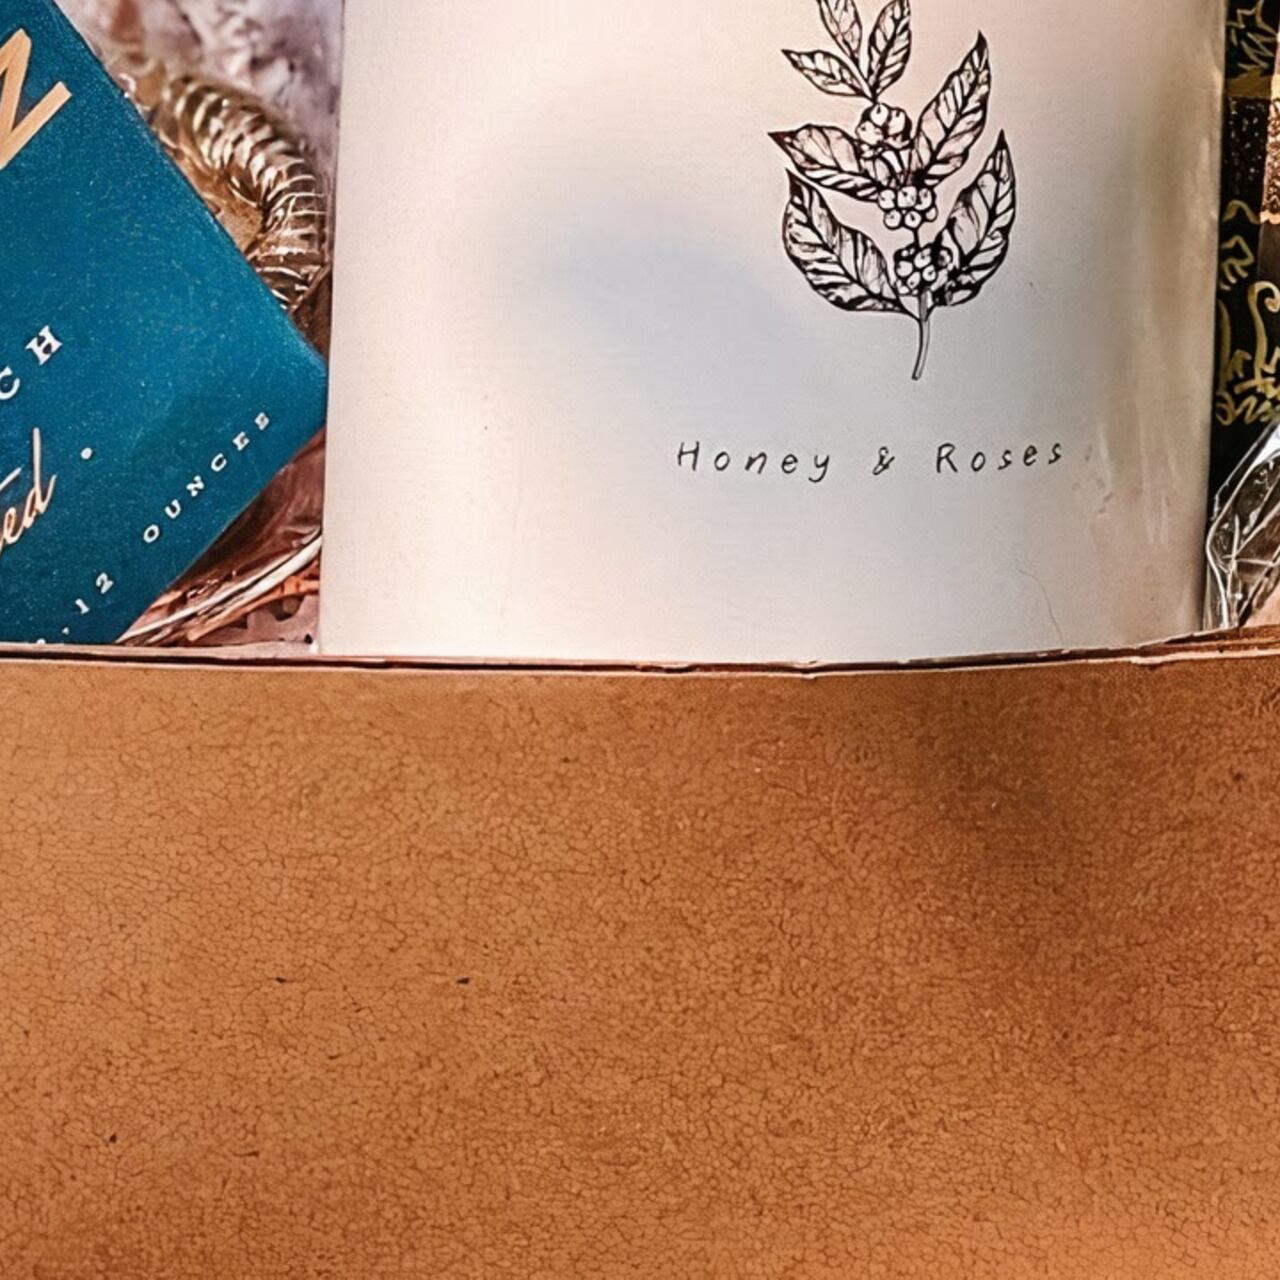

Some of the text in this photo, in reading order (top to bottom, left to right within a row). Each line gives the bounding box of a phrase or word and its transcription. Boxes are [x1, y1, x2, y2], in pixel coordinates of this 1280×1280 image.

[142, 411, 271, 544] OUNCES
[676, 440, 1063, 483] Honey & Roses
